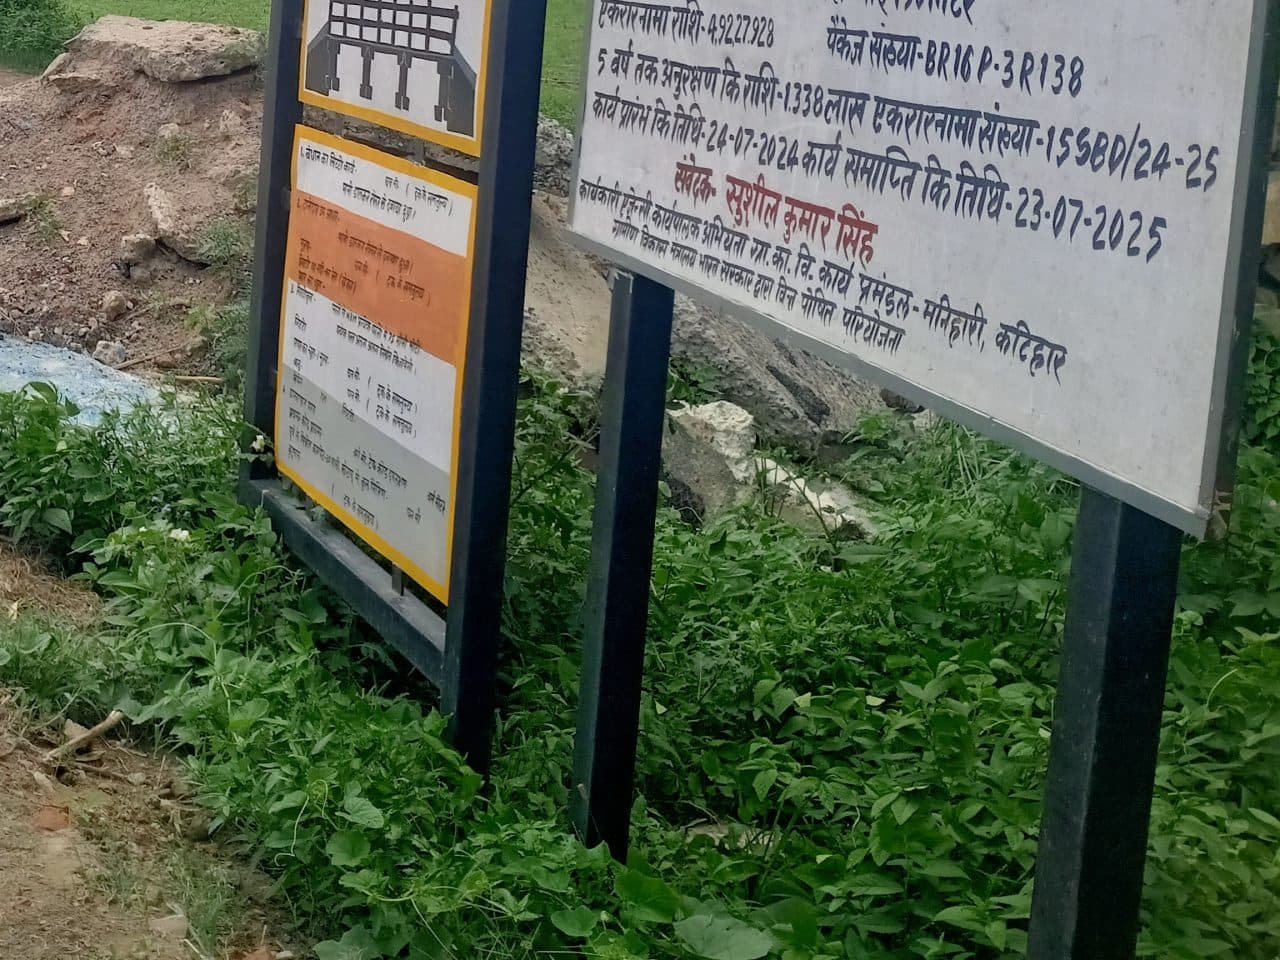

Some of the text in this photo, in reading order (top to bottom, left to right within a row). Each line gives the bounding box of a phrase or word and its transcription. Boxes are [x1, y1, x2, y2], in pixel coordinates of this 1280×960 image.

[592, 85, 619, 123] कार्य
[651, 97, 672, 138] कि
[802, 129, 843, 183] कार्य
[844, 145, 923, 202] समाप्ति
[921, 153, 952, 213] कि
[597, 48, 607, 77] 5
[610, 39, 634, 80] वर्ष
[634, 53, 659, 88] तक
[721, 56, 741, 104] कि
[872, 95, 982, 147] एकरारनामा
[725, 172, 783, 229] सुशील
[782, 196, 836, 251] कुमार
[836, 202, 879, 271] सिंह
[818, 261, 855, 301] कार्य
[995, 320, 1067, 387] कटिहार
